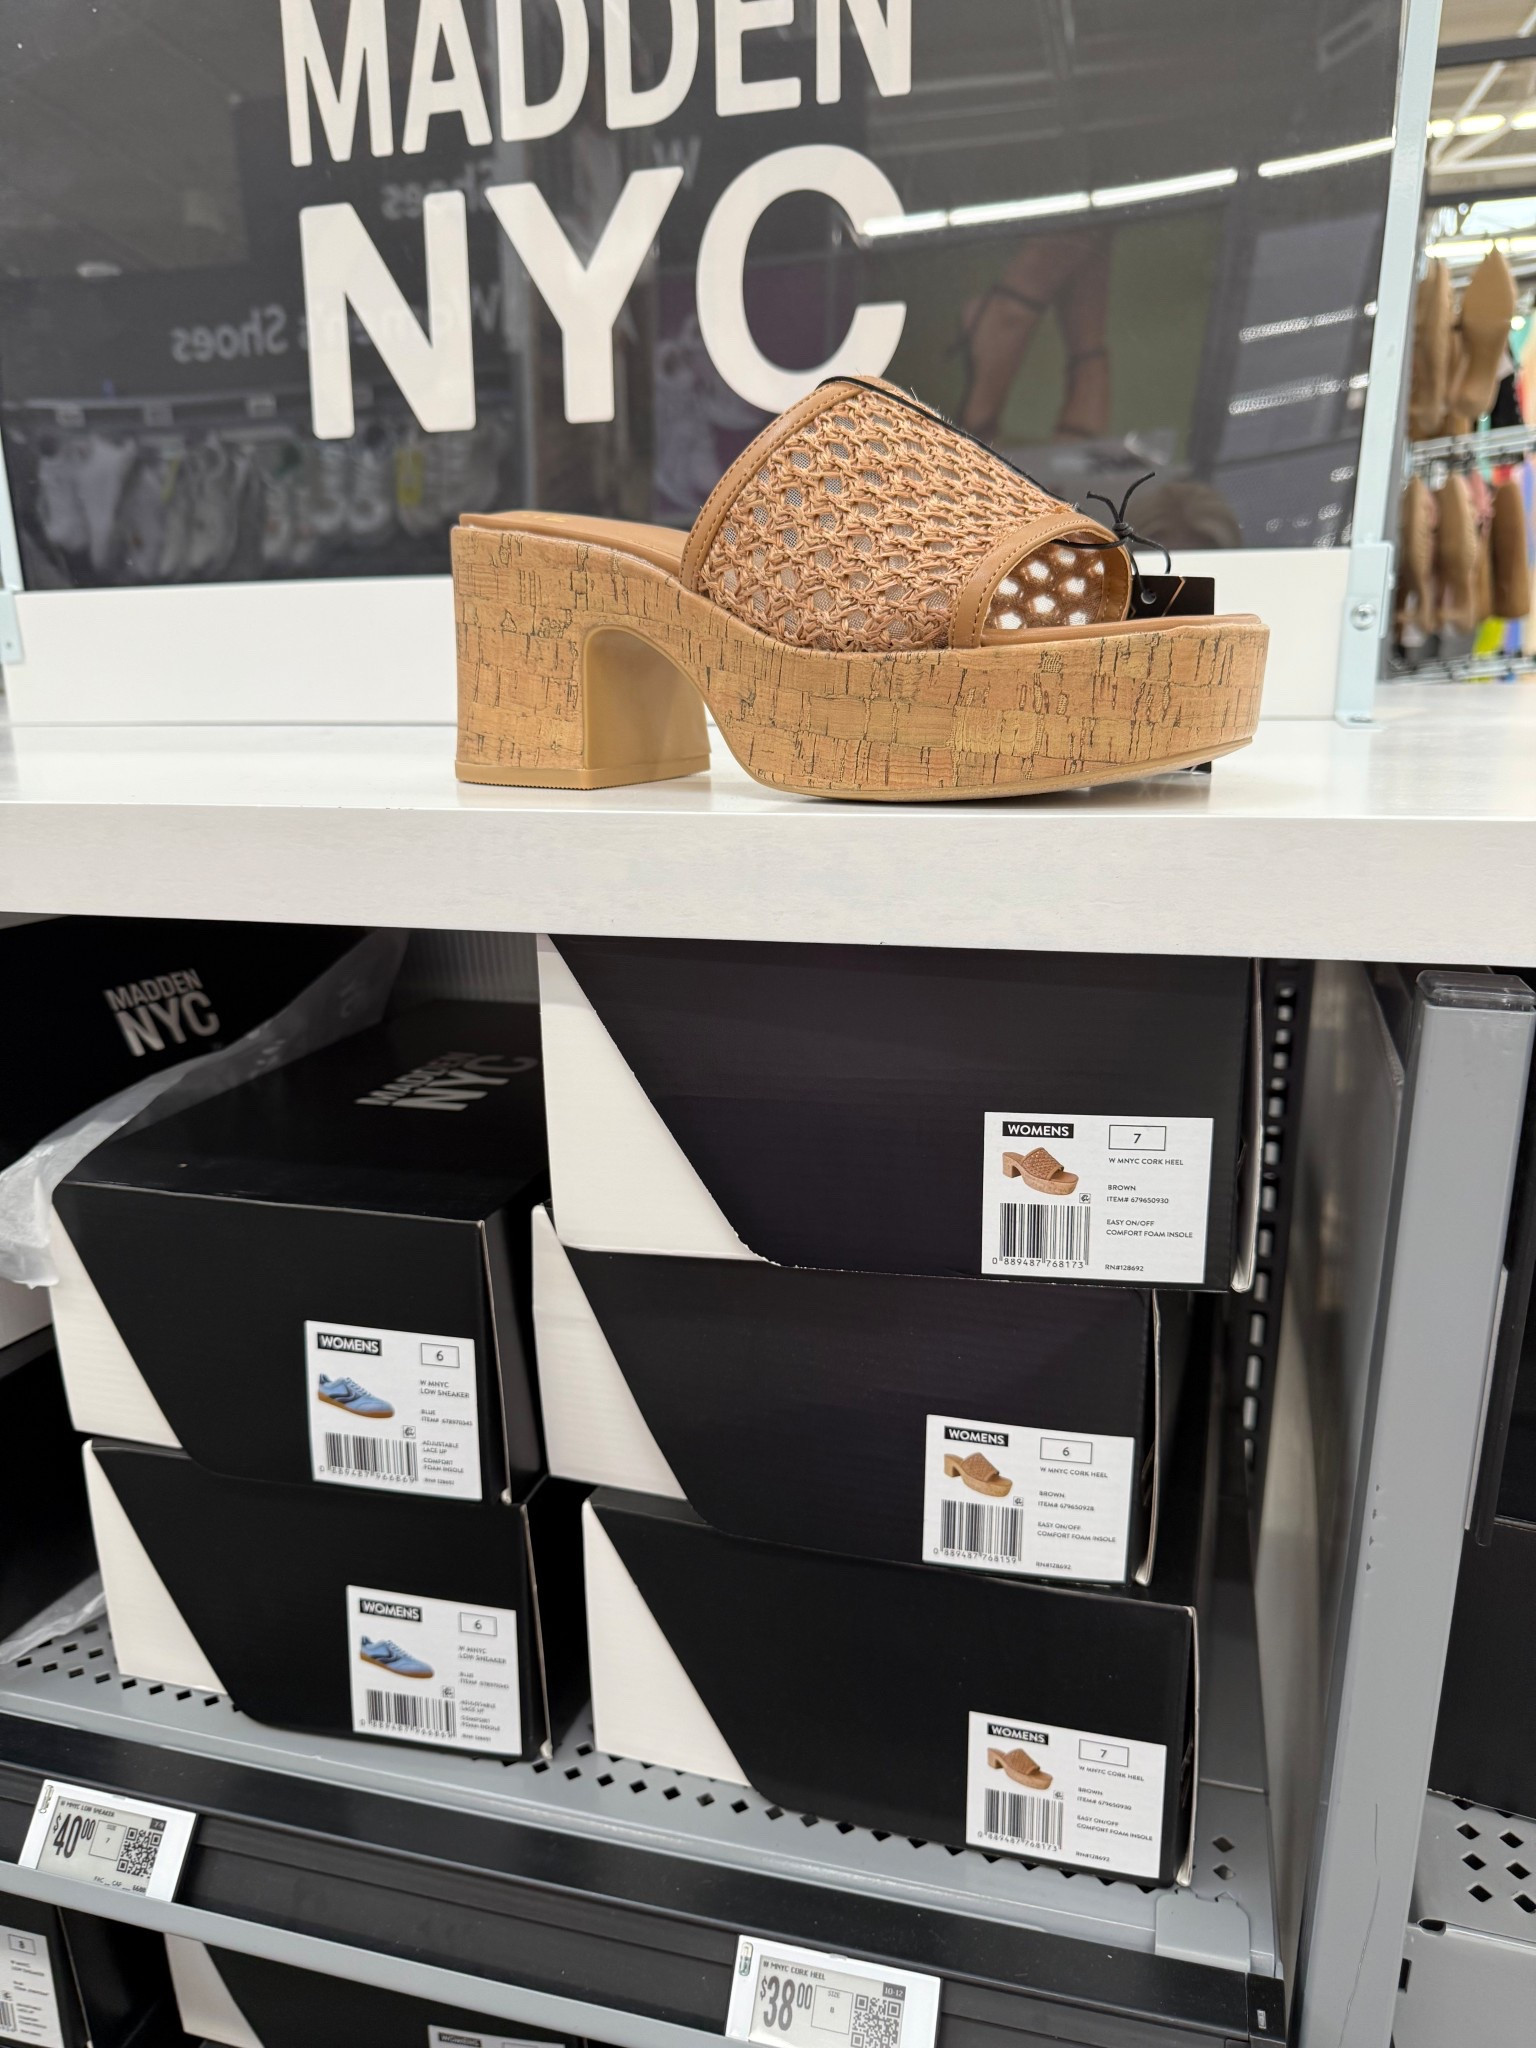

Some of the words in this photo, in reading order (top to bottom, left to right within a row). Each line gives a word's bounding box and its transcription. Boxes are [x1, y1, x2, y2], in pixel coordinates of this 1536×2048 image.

[281, 0, 913, 168] MADDEN
[298, 145, 907, 439] NYC
[103, 968, 203, 1012] MADDEN
[114, 991, 220, 1057] NYC
[392, 1054, 538, 1111] NYC
[1007, 1124, 1069, 1136] WOMENS
[1133, 1133, 1141, 1143] 7
[320, 1335, 379, 1353] WOMENS
[436, 1351, 443, 1361] 6
[420, 1387, 436, 1395] LOW
[438, 1389, 469, 1398] SNEAKER
[948, 1429, 1004, 1444] WOMENS
[1063, 1447, 1069, 1456] 6
[1037, 1530, 1070, 1539] COMFORT
[363, 1601, 419, 1619] WOMENS
[475, 1619, 481, 1629] 6
[991, 1726, 1045, 1742] WOMENS
[1100, 1749, 1107, 1757] 7
[1107, 1769, 1126, 1777] CORK
[1078, 1787, 1103, 1795] BROWN
[1076, 1822, 1108, 1833] COMFORT
[1129, 1832, 1153, 1840] INSOLE
[790, 1966, 809, 1976] CORK
[810, 1971, 826, 1980] HEEL
